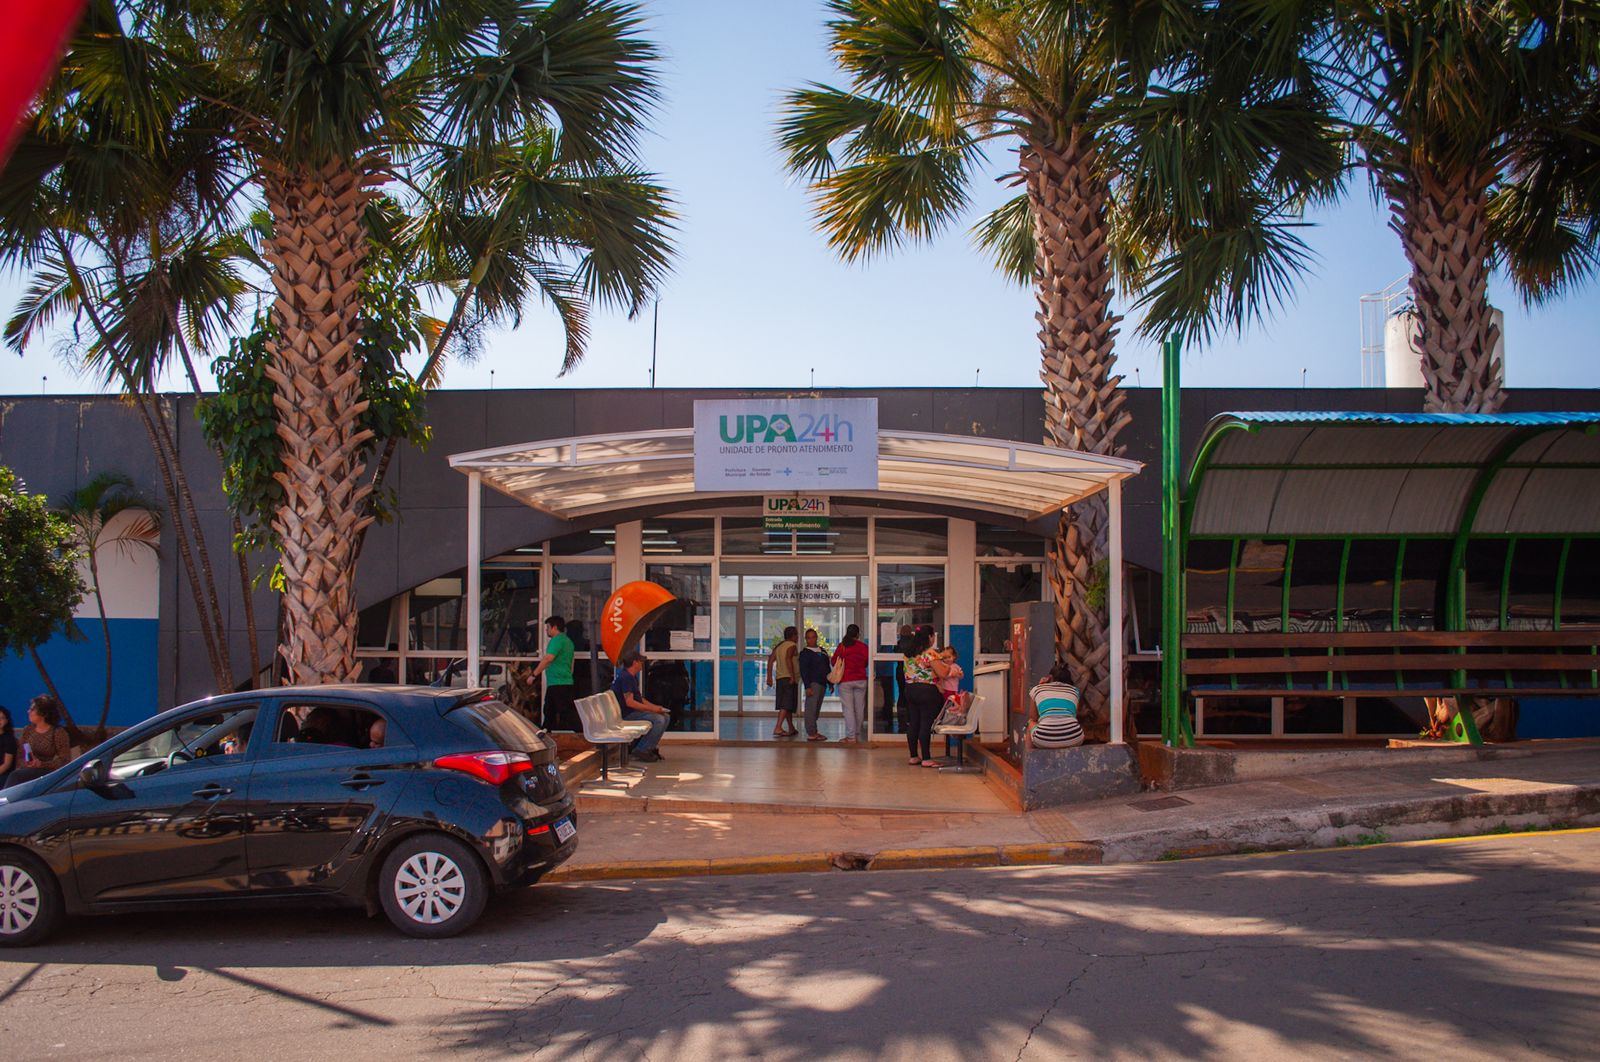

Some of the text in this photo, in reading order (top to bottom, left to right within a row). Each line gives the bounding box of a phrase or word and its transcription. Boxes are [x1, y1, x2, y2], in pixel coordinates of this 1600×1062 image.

[719, 444, 853, 454] UNIDADE DE PRONTO ATENDIMENTO
[768, 592, 840, 600] PARA ATENDIMENTO
[609, 596, 624, 633] vivo
